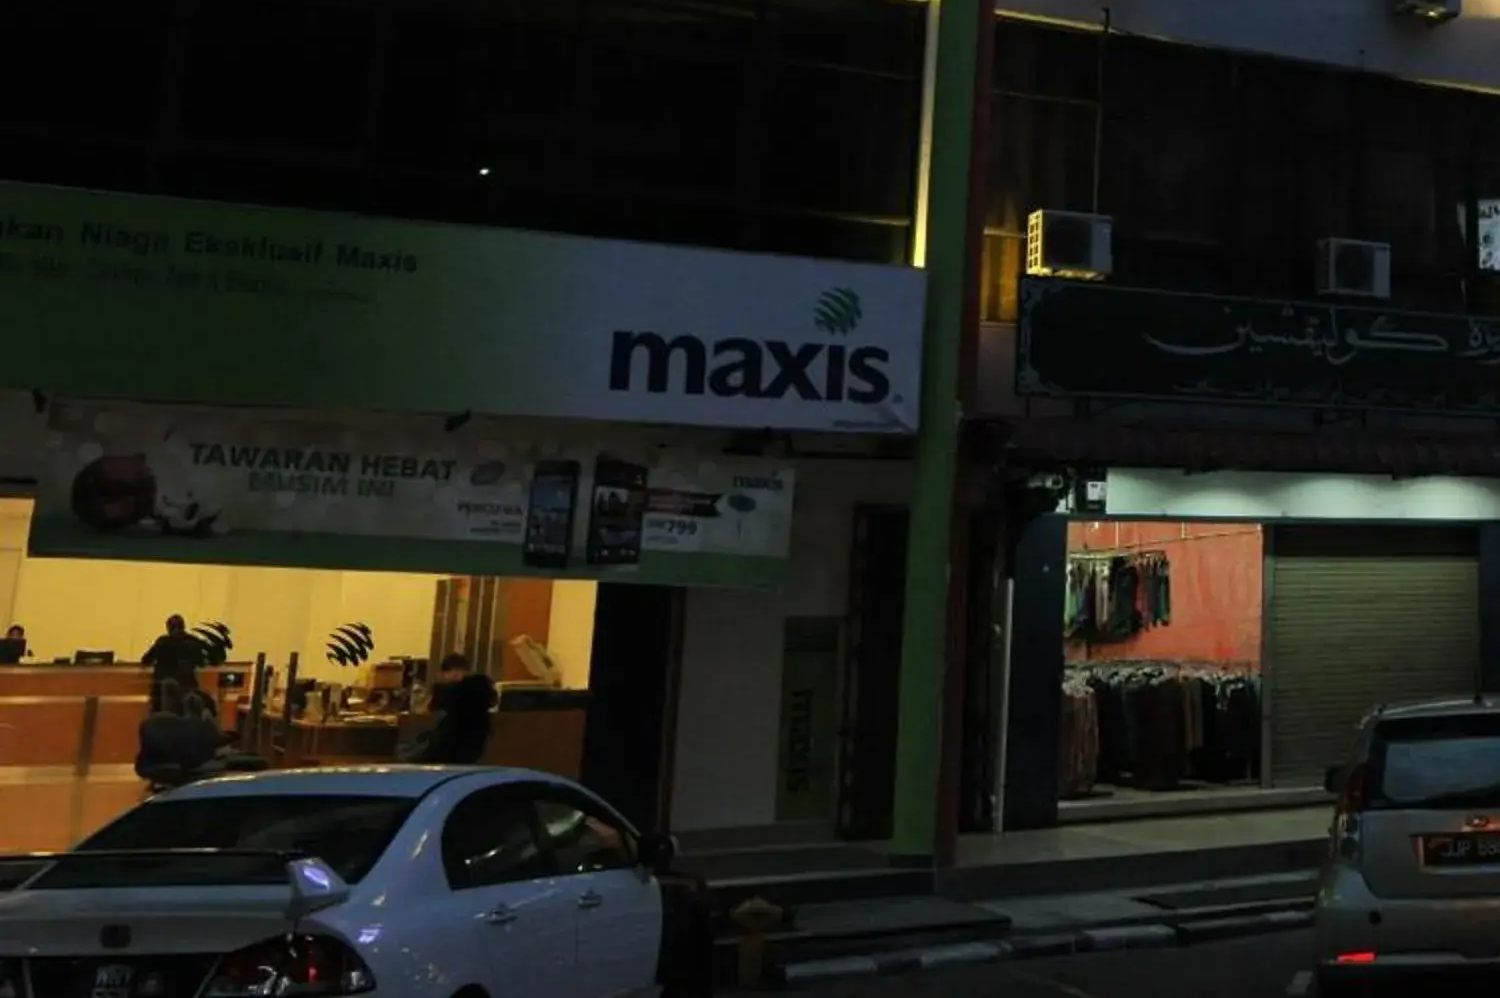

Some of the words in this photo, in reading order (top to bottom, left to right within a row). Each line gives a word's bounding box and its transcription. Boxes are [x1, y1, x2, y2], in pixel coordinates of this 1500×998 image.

[0, 213, 64, 243] kan
[80, 219, 171, 256] Niaga
[336, 243, 418, 273] Maxis
[609, 329, 890, 404] maxis
[189, 442, 351, 473] TAWARAN
[360, 454, 458, 480] HEBAT
